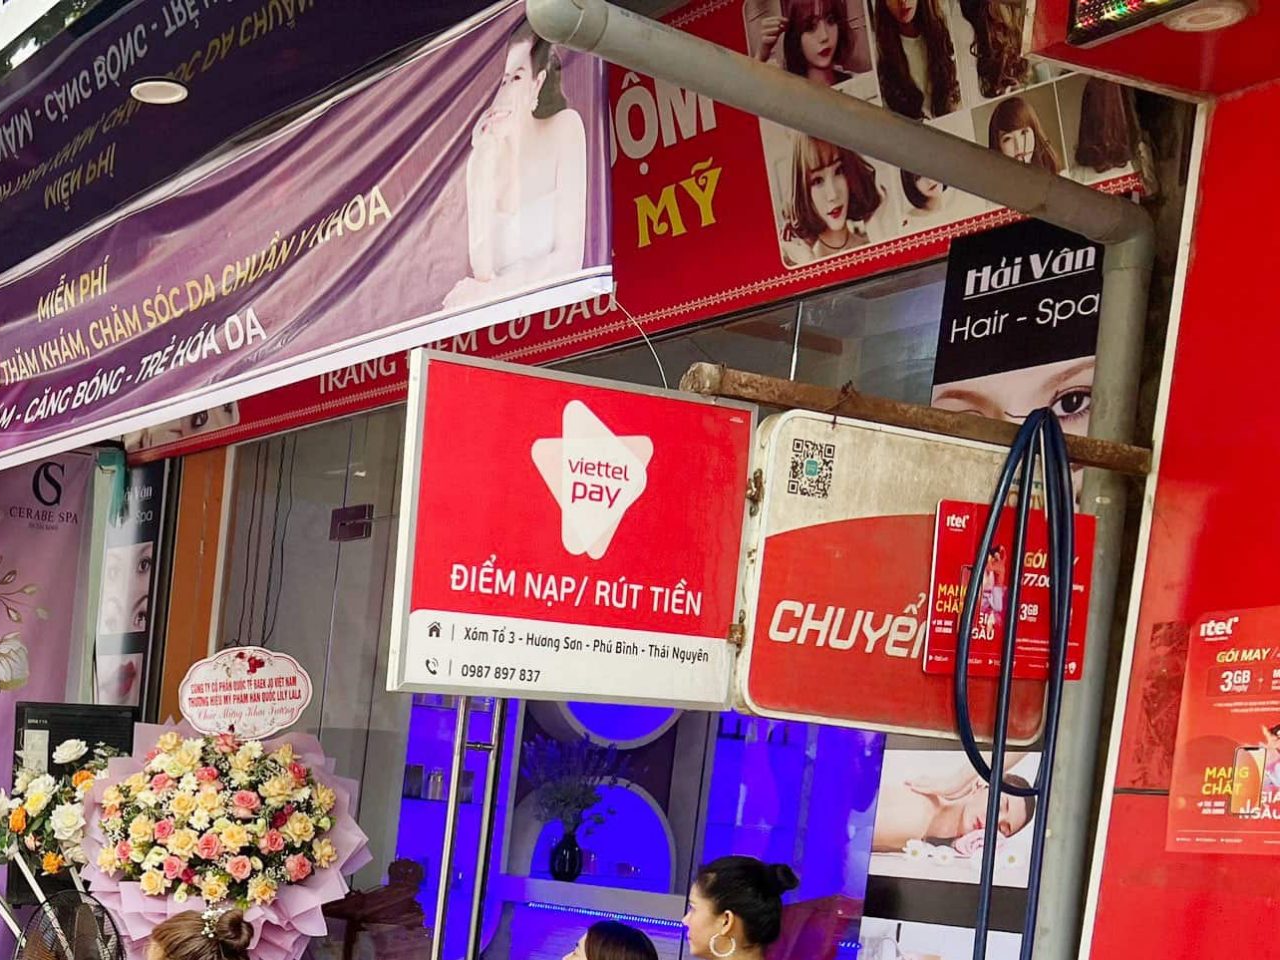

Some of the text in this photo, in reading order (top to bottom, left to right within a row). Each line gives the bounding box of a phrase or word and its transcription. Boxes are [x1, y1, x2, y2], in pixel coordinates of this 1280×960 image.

[633, 156, 722, 248] MỸ
[37, 255, 110, 323] MIỄN PHÍ
[964, 247, 1096, 297] Hải Vân
[0, 347, 40, 386] THĂM
[89, 304, 142, 349] CHĂM
[143, 285, 184, 328] SÓC
[186, 274, 216, 312] DA
[950, 293, 1101, 343] Hair Spa
[24, 386, 74, 424] CĂNG
[71, 368, 126, 410] BÓNG
[170, 320, 221, 370] HÓA
[224, 307, 267, 351] DA
[568, 457, 630, 481] viettel
[10, 505, 78, 524] CERABE SPA
[571, 480, 622, 509] pay
[450, 554, 516, 597] ĐIỂM
[594, 576, 643, 610] RÚT
[649, 578, 703, 617] TIỀN
[463, 627, 489, 642] Xóm
[508, 632, 516, 643] 3
[593, 639, 613, 654] Phú
[672, 647, 709, 665] Nguyên
[1240, 648, 1271, 662] MAY
[461, 663, 541, 684] 0987 897 837
